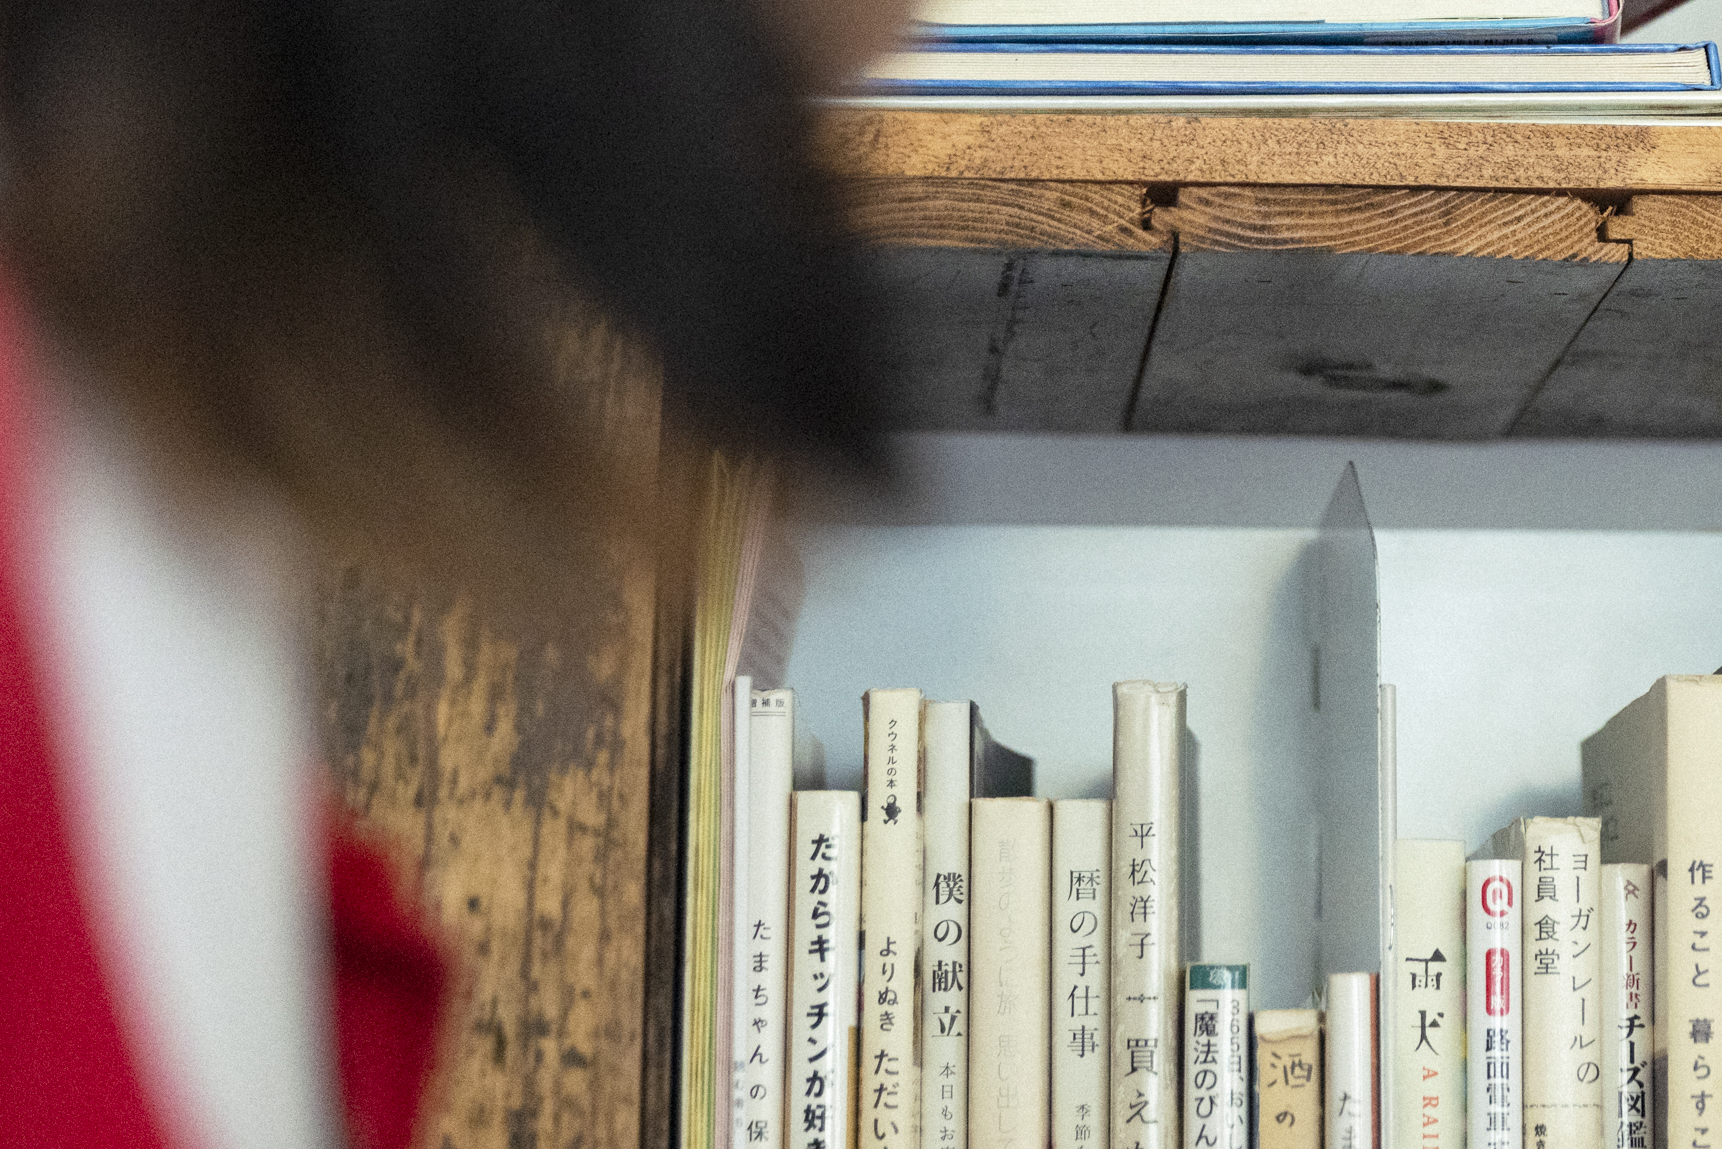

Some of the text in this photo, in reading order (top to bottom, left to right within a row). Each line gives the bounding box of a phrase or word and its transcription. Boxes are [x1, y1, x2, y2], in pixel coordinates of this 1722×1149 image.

[885, 718, 898, 790] クウネルの本
[931, 872, 966, 1149] 僕の献立 本日もお
[1066, 867, 1102, 1149] 暦の手仕事 季節
[1124, 820, 1158, 1149] 平松洋子 買え
[1533, 845, 1562, 976] 社員食堂
[1569, 851, 1601, 1084] ヨーガンレールの
[1687, 859, 1715, 1149] 作ること 暮らすこ
[747, 918, 772, 1143] たまちゃんの保
[873, 936, 900, 1149] よりぬき ただい
[1192, 998, 1220, 1148] 「魔法のびん
[1266, 1051, 1313, 1128] 酒の
[1422, 1065, 1439, 1149] A RAI
[1485, 1028, 1511, 1149] 路面電車
[1617, 918, 1647, 1149] カラー新書 チーズ図鑑
